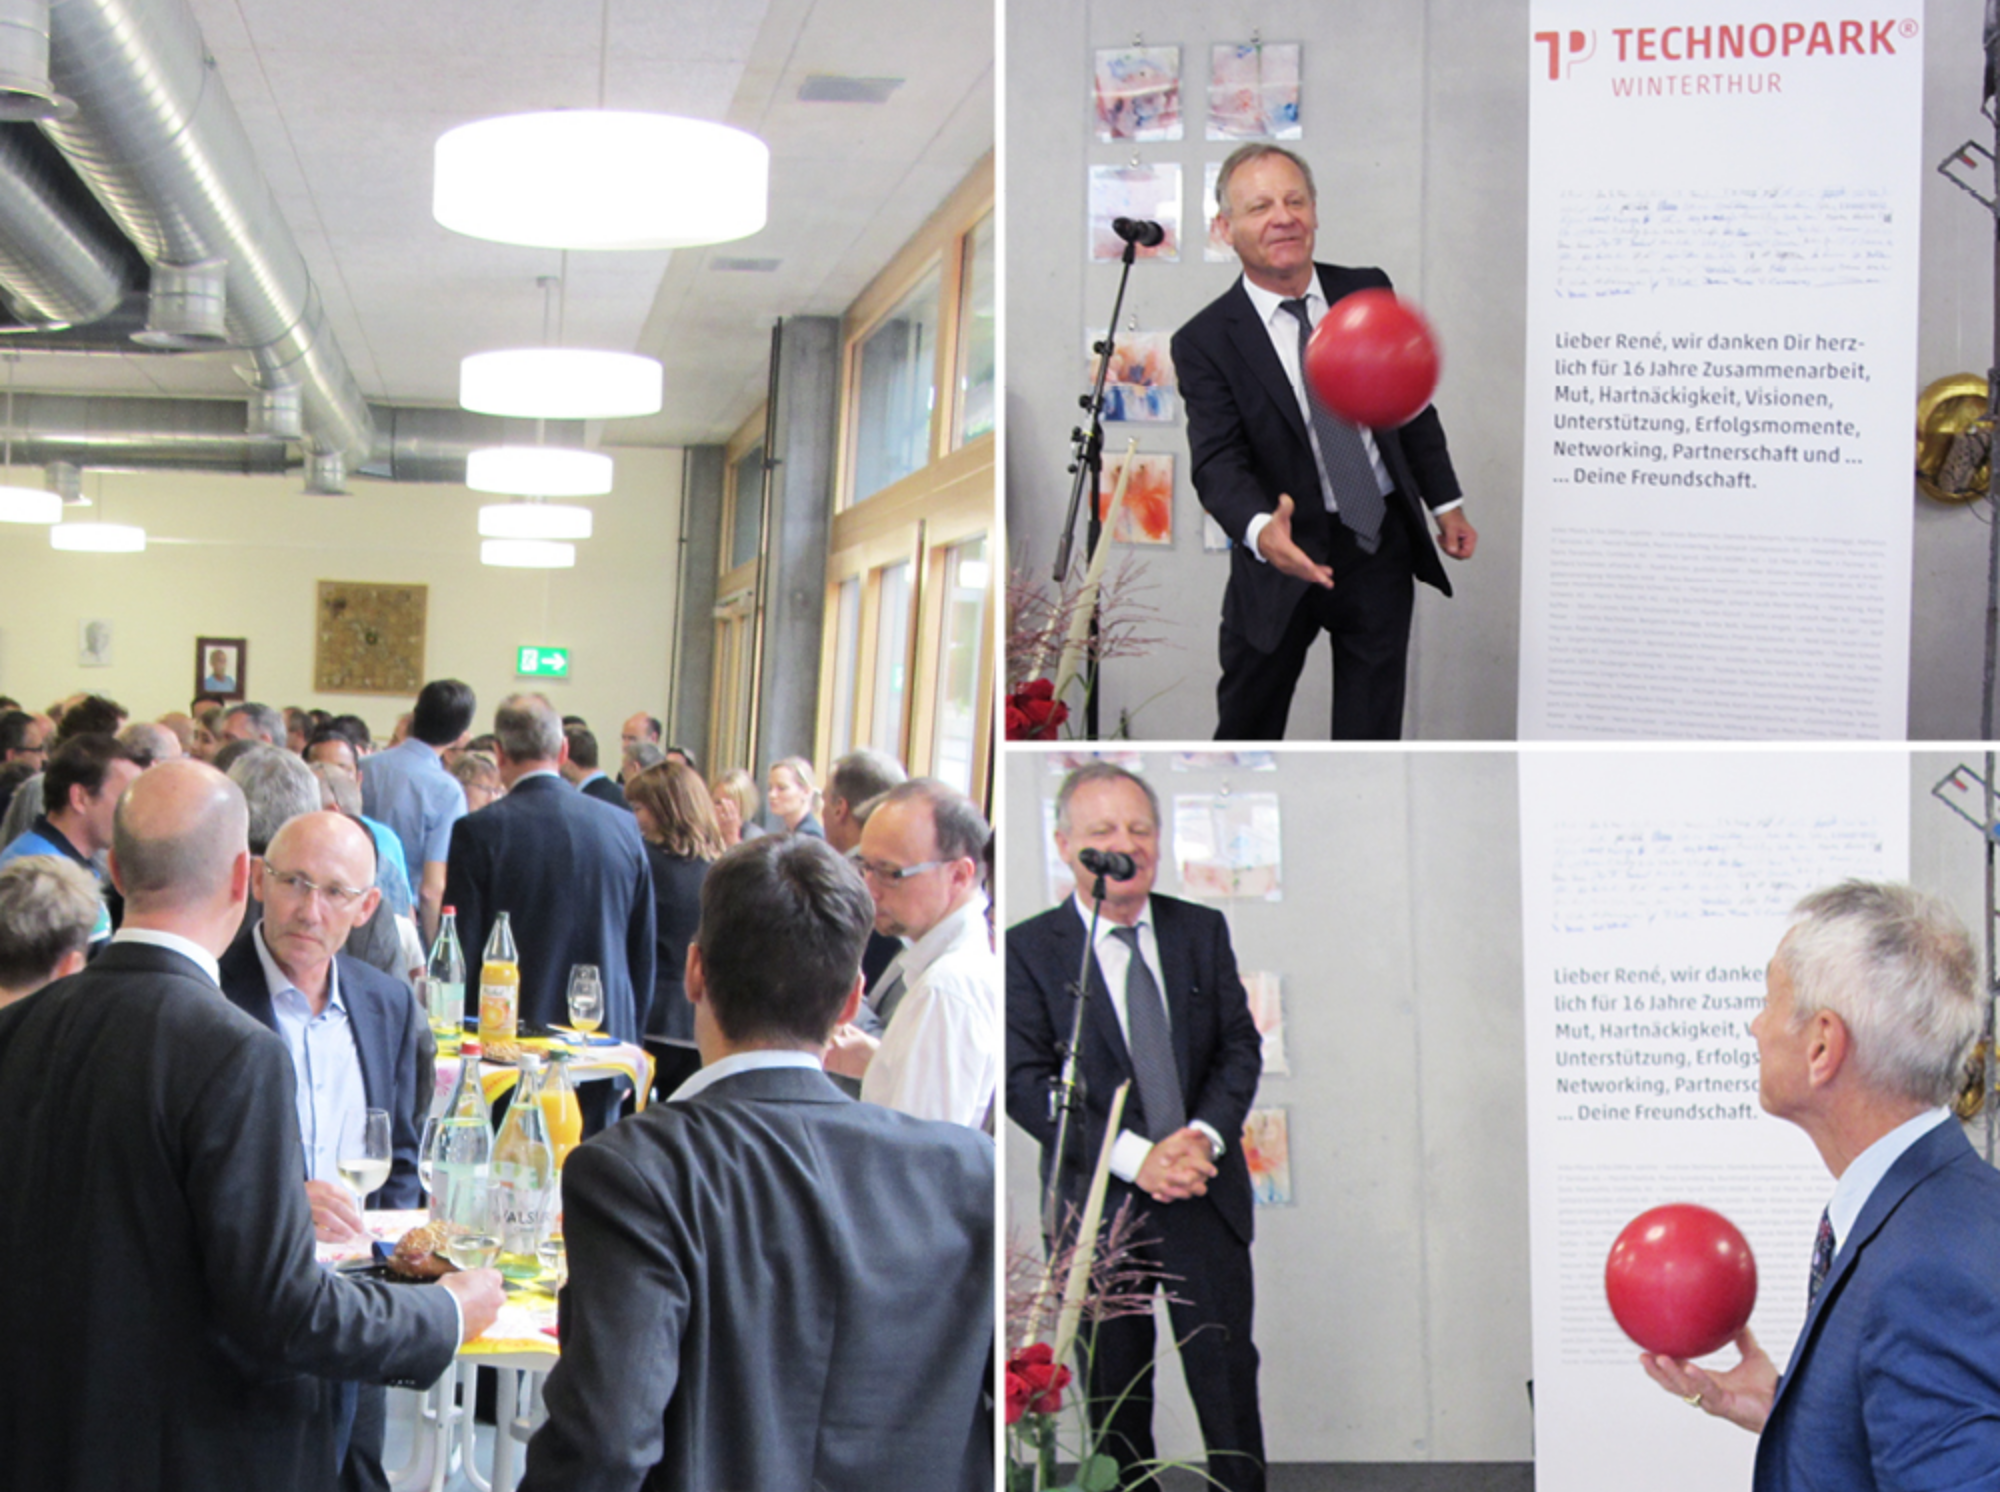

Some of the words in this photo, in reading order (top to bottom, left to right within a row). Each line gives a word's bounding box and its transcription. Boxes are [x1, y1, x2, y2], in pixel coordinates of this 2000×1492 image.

[1611, 72, 1783, 97] WINTERTHUR
[1555, 332, 1611, 350] Lieber
[1616, 331, 1668, 352] René,
[1672, 332, 1703, 350] wir
[1707, 333, 1779, 351] danken
[1784, 333, 1812, 351] Dir
[1816, 333, 1866, 352] herz-
[1555, 359, 1587, 377] lich
[1592, 359, 1619, 377] für
[1624, 360, 1646, 377] 16
[1650, 360, 1698, 378] Jahre
[1703, 361, 1871, 383] Zusammenarbeit,
[1554, 385, 1595, 406] Mut,
[1599, 385, 1741, 408] Hartnäckigkeit,
[1745, 387, 1834, 410] Visionen,
[1554, 413, 1691, 436] Unterstützung,
[1696, 416, 1861, 439] Erfolgsmomente,
[1553, 440, 1668, 463] Networking,
[1673, 443, 1799, 463] Partnerschaft
[1803, 446, 1841, 465] und
[1574, 468, 1627, 486] Deine
[1632, 469, 1757, 489] Freundschaft.
[1554, 967, 1610, 985] Lieber
[1615, 965, 1667, 987] René,
[1671, 966, 1701, 984] wir
[1705, 965, 1763, 983] danke
[1554, 995, 1587, 1012] lich
[1592, 994, 1617, 1012] für
[1623, 995, 1645, 1012] 16
[1649, 994, 1698, 1011] Jahre
[1555, 1022, 1595, 1042] Mut,
[1600, 1020, 1741, 1042] Hartnäckigkeit,
[1556, 1048, 1692, 1069] Unterstützung,
[1556, 1076, 1670, 1097] Networking,
[1577, 1103, 1631, 1121] Deine
[1635, 1102, 1759, 1121] Freundschaft.
